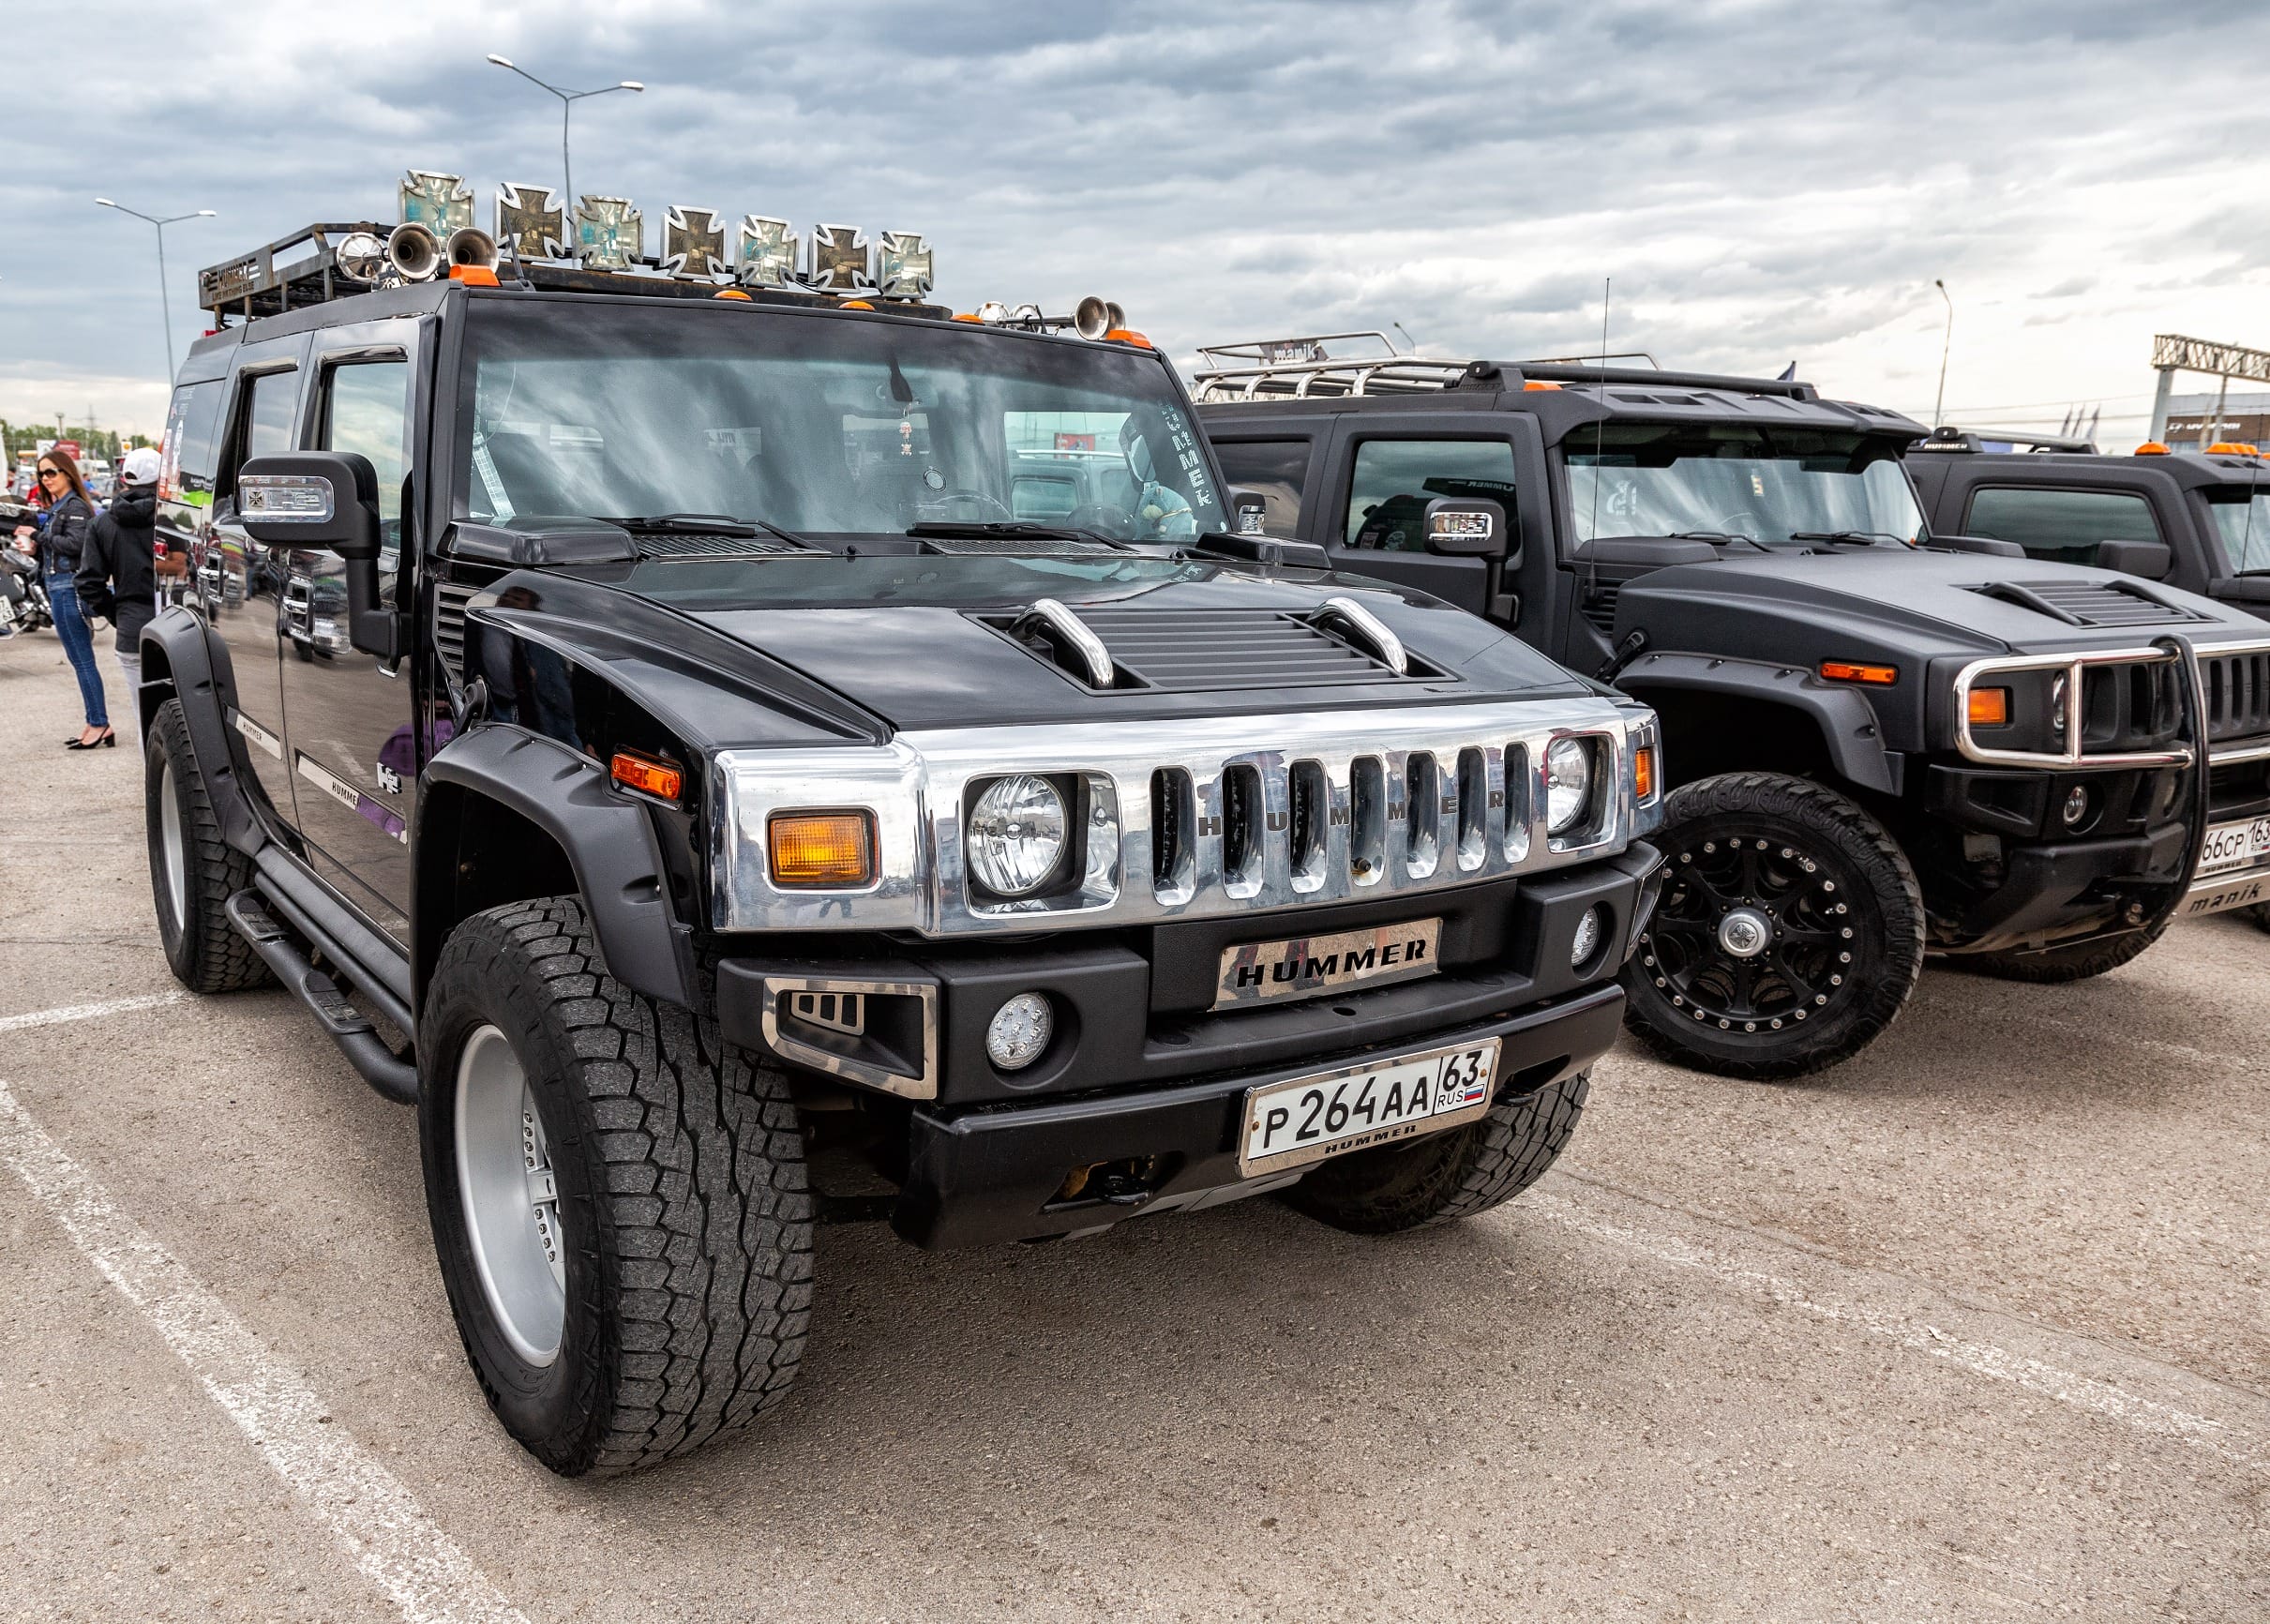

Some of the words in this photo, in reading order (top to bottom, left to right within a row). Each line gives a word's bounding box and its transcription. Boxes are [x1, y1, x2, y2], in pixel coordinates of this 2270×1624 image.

[2188, 882, 2262, 913] manik
[1237, 939, 1426, 987] HUMMER
[1442, 1050, 1482, 1092] 63
[1437, 1088, 1464, 1107] RUS
[1325, 1125, 1417, 1154] HUMMER
